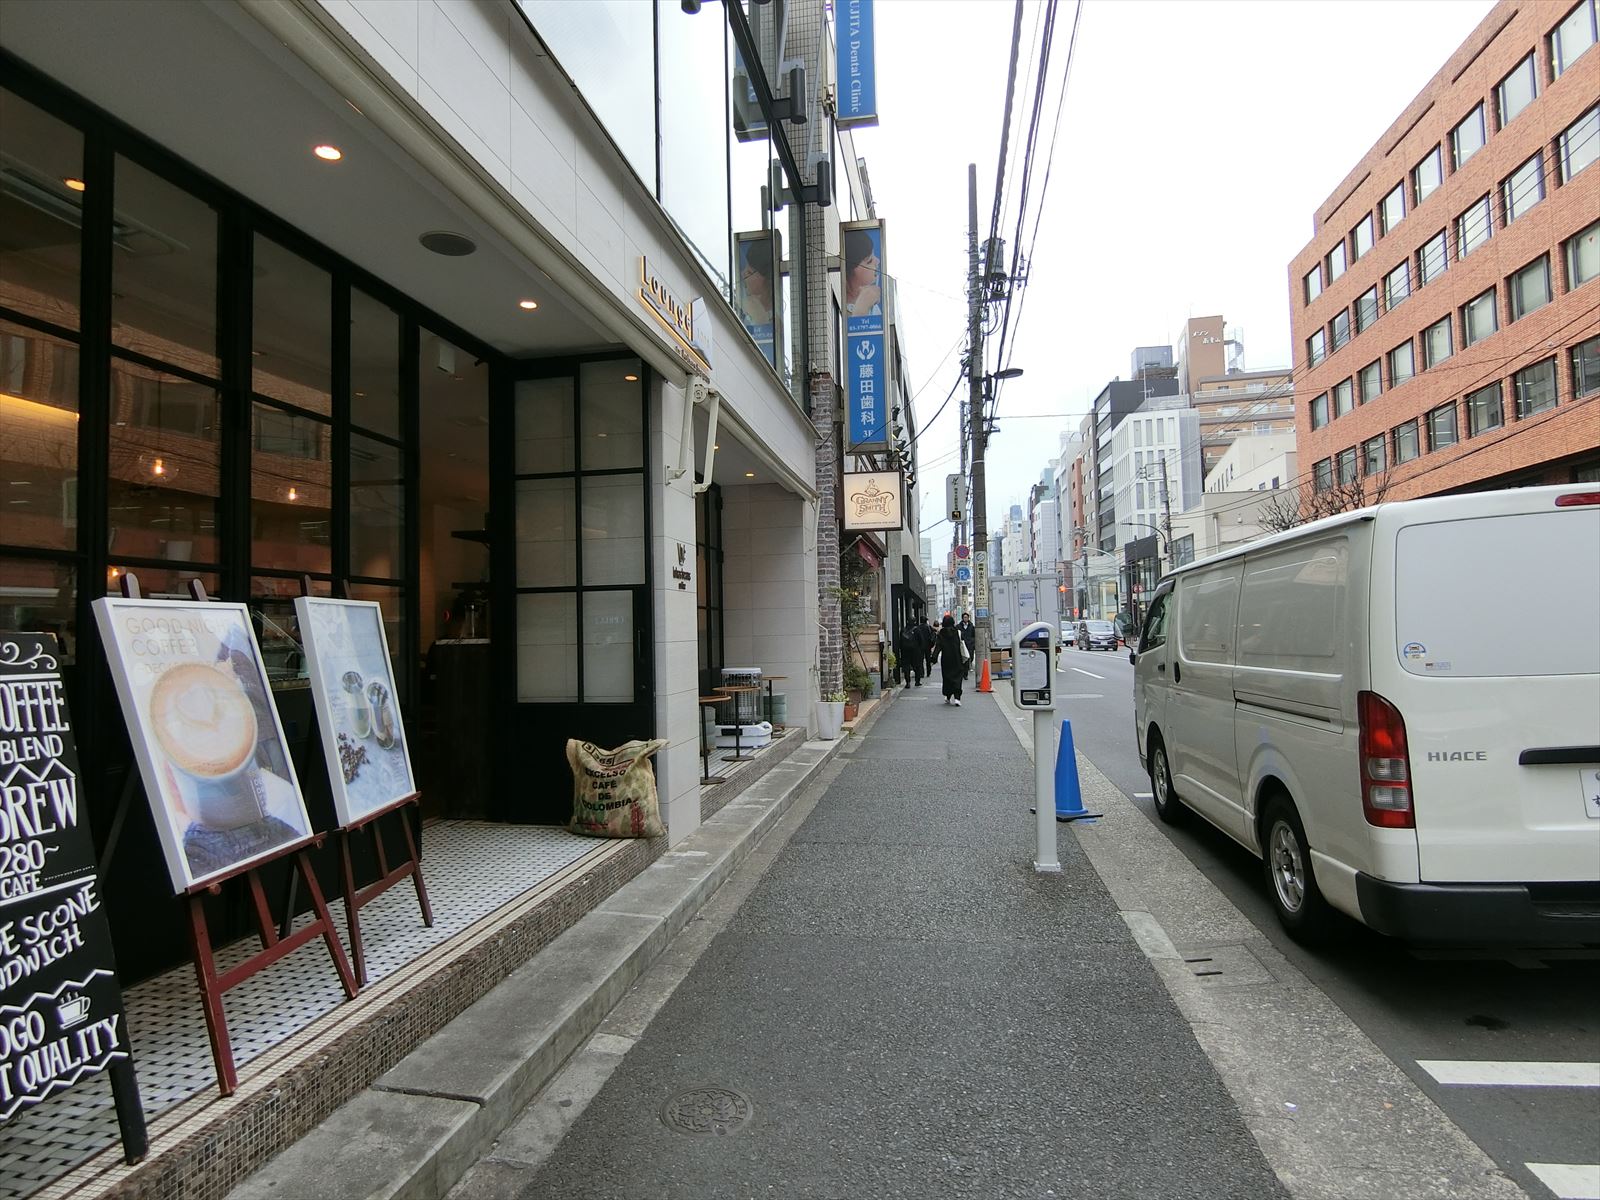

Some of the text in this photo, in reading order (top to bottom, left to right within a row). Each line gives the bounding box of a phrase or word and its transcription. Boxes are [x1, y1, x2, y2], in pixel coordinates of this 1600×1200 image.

[850, 41, 861, 77] Dental
[851, 78, 862, 113] Clinic
[859, 364, 876, 426] 藤田歯科
[863, 430, 873, 438] 3F
[859, 504, 886, 513] SMITH
[0, 734, 64, 765] BLEND
[1428, 751, 1487, 762] HIACE
[598, 792, 612, 800] DE
[1, 870, 44, 899] CAFE
[21, 881, 101, 945] SCONE
[19, 1013, 120, 1093] QUALITY
